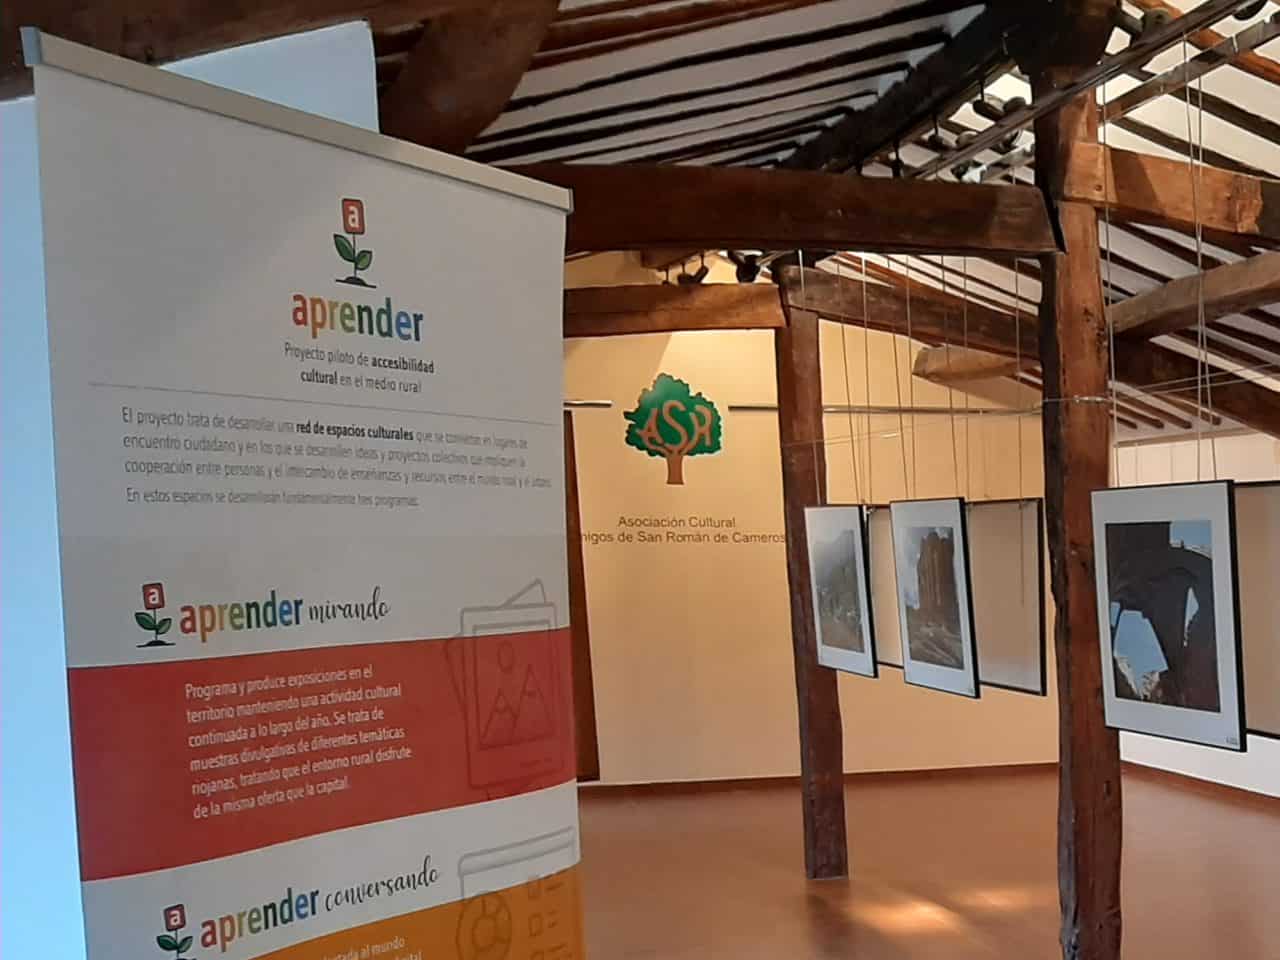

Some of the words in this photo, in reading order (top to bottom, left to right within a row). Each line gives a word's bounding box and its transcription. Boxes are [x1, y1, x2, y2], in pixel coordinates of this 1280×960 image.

[292, 294, 423, 341] aprender
[284, 342, 324, 361] Proyecto
[328, 350, 354, 365] piloto
[357, 352, 368, 366] de
[372, 355, 434, 374] accesibilidad
[300, 369, 337, 384] cultural
[340, 374, 352, 386] en
[355, 374, 363, 387] el
[366, 375, 396, 390] medio
[399, 377, 421, 393] rural
[121, 406, 133, 423] El
[137, 411, 184, 429] proyecto
[213, 413, 225, 428] de
[296, 418, 311, 434] red
[314, 420, 325, 436] de
[327, 424, 366, 440] espacios
[368, 426, 413, 441] culturales
[123, 435, 180, 450] encuentro
[127, 487, 139, 502] En
[618, 515, 686, 529] Asociación
[689, 515, 736, 529] Cultural
[618, 531, 633, 543] de
[637, 531, 662, 543] San
[666, 530, 710, 543] Román
[713, 532, 729, 543] de
[732, 532, 785, 544] Cameros
[180, 589, 304, 643] aprender
[308, 586, 389, 624] mirando
[185, 682, 237, 700] Programa
[237, 682, 245, 696] y
[247, 676, 285, 694] produce
[288, 670, 347, 688] exposiciones
[349, 667, 360, 681] en
[363, 664, 372, 678] el
[187, 706, 233, 723] territorio
[236, 698, 299, 716] manteniendo
[301, 694, 318, 708] una
[320, 687, 362, 705] actividad
[365, 683, 401, 700] cultural
[188, 728, 248, 748] continuada
[258, 722, 268, 736] lo
[270, 718, 292, 737] largo
[295, 715, 309, 730] del
[333, 710, 345, 726] Se
[348, 708, 370, 722] trata
[371, 706, 384, 720] de
[190, 752, 239, 772] muestras
[297, 740, 309, 753] de
[311, 733, 358, 751] diferentes
[359, 727, 405, 744] temáticas
[240, 768, 280, 786] tratando
[282, 764, 300, 780] que
[302, 760, 311, 774] el
[312, 756, 349, 773] entorno
[351, 751, 374, 767] rural
[376, 747, 412, 763] disfrute
[194, 802, 208, 819] de
[210, 800, 220, 815] la
[223, 796, 254, 814] misma
[257, 789, 284, 806] oferta
[286, 786, 305, 802] que
[306, 783, 315, 796] la
[200, 887, 320, 952] aprender
[325, 855, 439, 912] conversando
[360, 945, 369, 958] al
[372, 936, 405, 954] mundo
